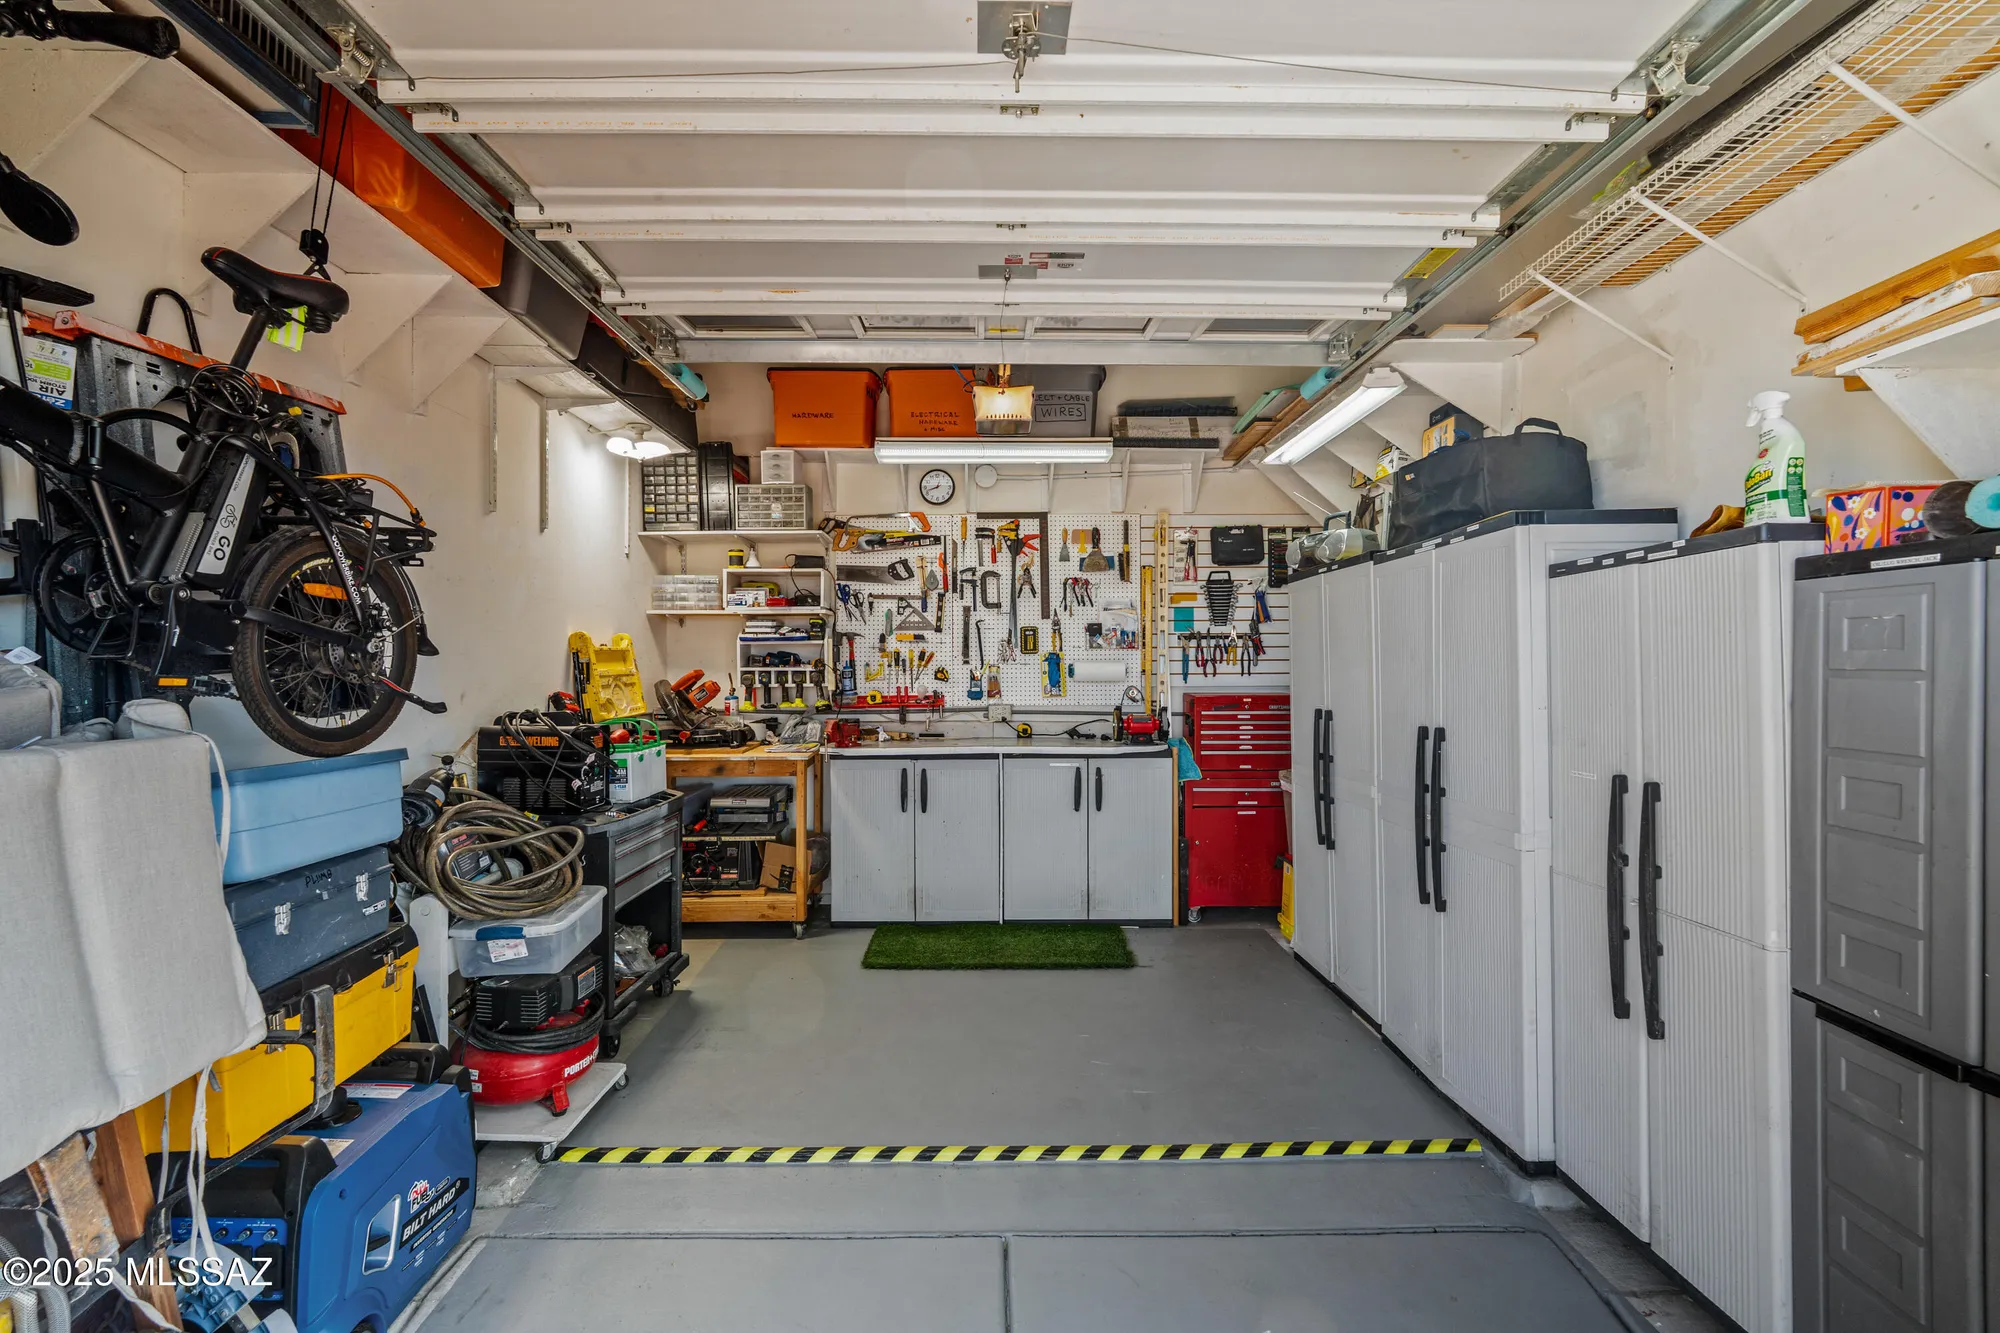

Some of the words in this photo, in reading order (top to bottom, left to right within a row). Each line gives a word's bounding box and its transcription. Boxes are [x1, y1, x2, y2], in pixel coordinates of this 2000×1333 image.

[39, 384, 67, 396] AIR
[40, 379, 67, 389] STORM
[1034, 394, 1055, 402] LECT
[1063, 394, 1090, 402] CABLE
[1040, 406, 1083, 418] WIRES
[213, 535, 231, 561] GO
[331, 534, 362, 605] GOPOWERBIKE.COM
[526, 736, 560, 746] WELDING
[304, 868, 333, 888] PLUMB
[402, 1209, 428, 1242] BILT
